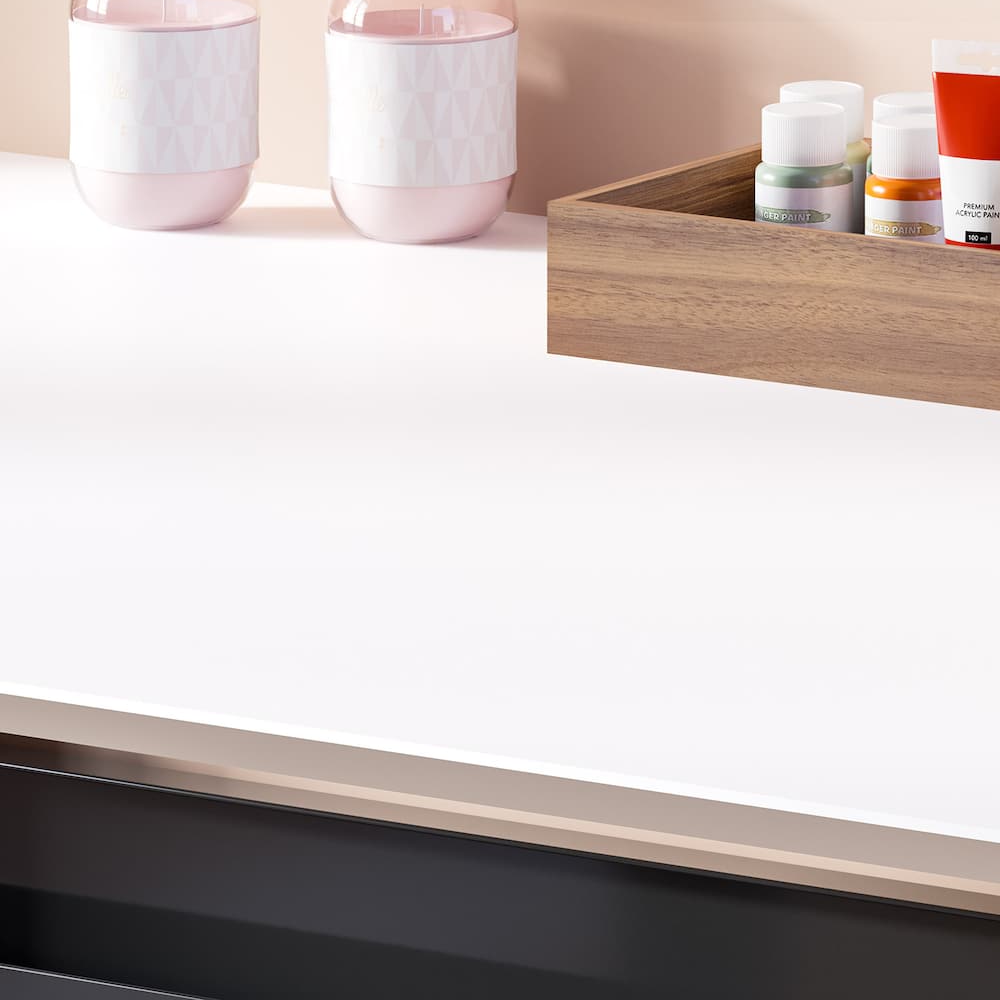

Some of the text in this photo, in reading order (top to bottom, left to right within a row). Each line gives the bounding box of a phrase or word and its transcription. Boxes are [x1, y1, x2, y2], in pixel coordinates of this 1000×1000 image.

[963, 202, 995, 211] PREMIUM
[761, 209, 812, 222] GER PAINT
[955, 209, 982, 218] ACRYLIC
[892, 226, 923, 234] PAINT
[968, 234, 979, 242] 100
